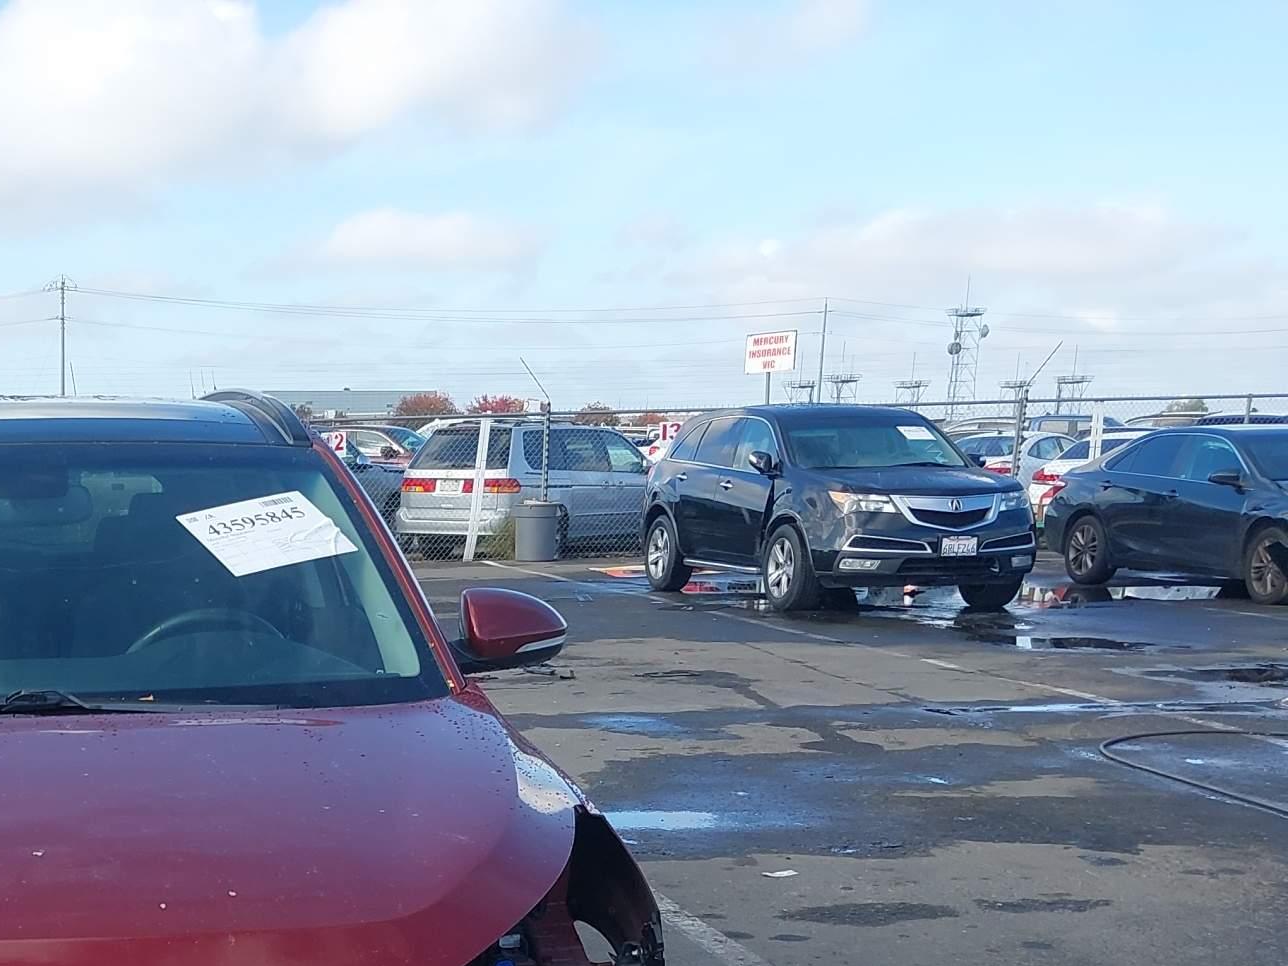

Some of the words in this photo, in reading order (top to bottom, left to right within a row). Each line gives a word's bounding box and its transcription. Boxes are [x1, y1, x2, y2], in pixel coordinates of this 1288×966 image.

[752, 335, 790, 347] MERCURY
[748, 347, 792, 359] INSURANCE
[762, 360, 777, 370] VIC
[208, 506, 306, 536] 43595845
